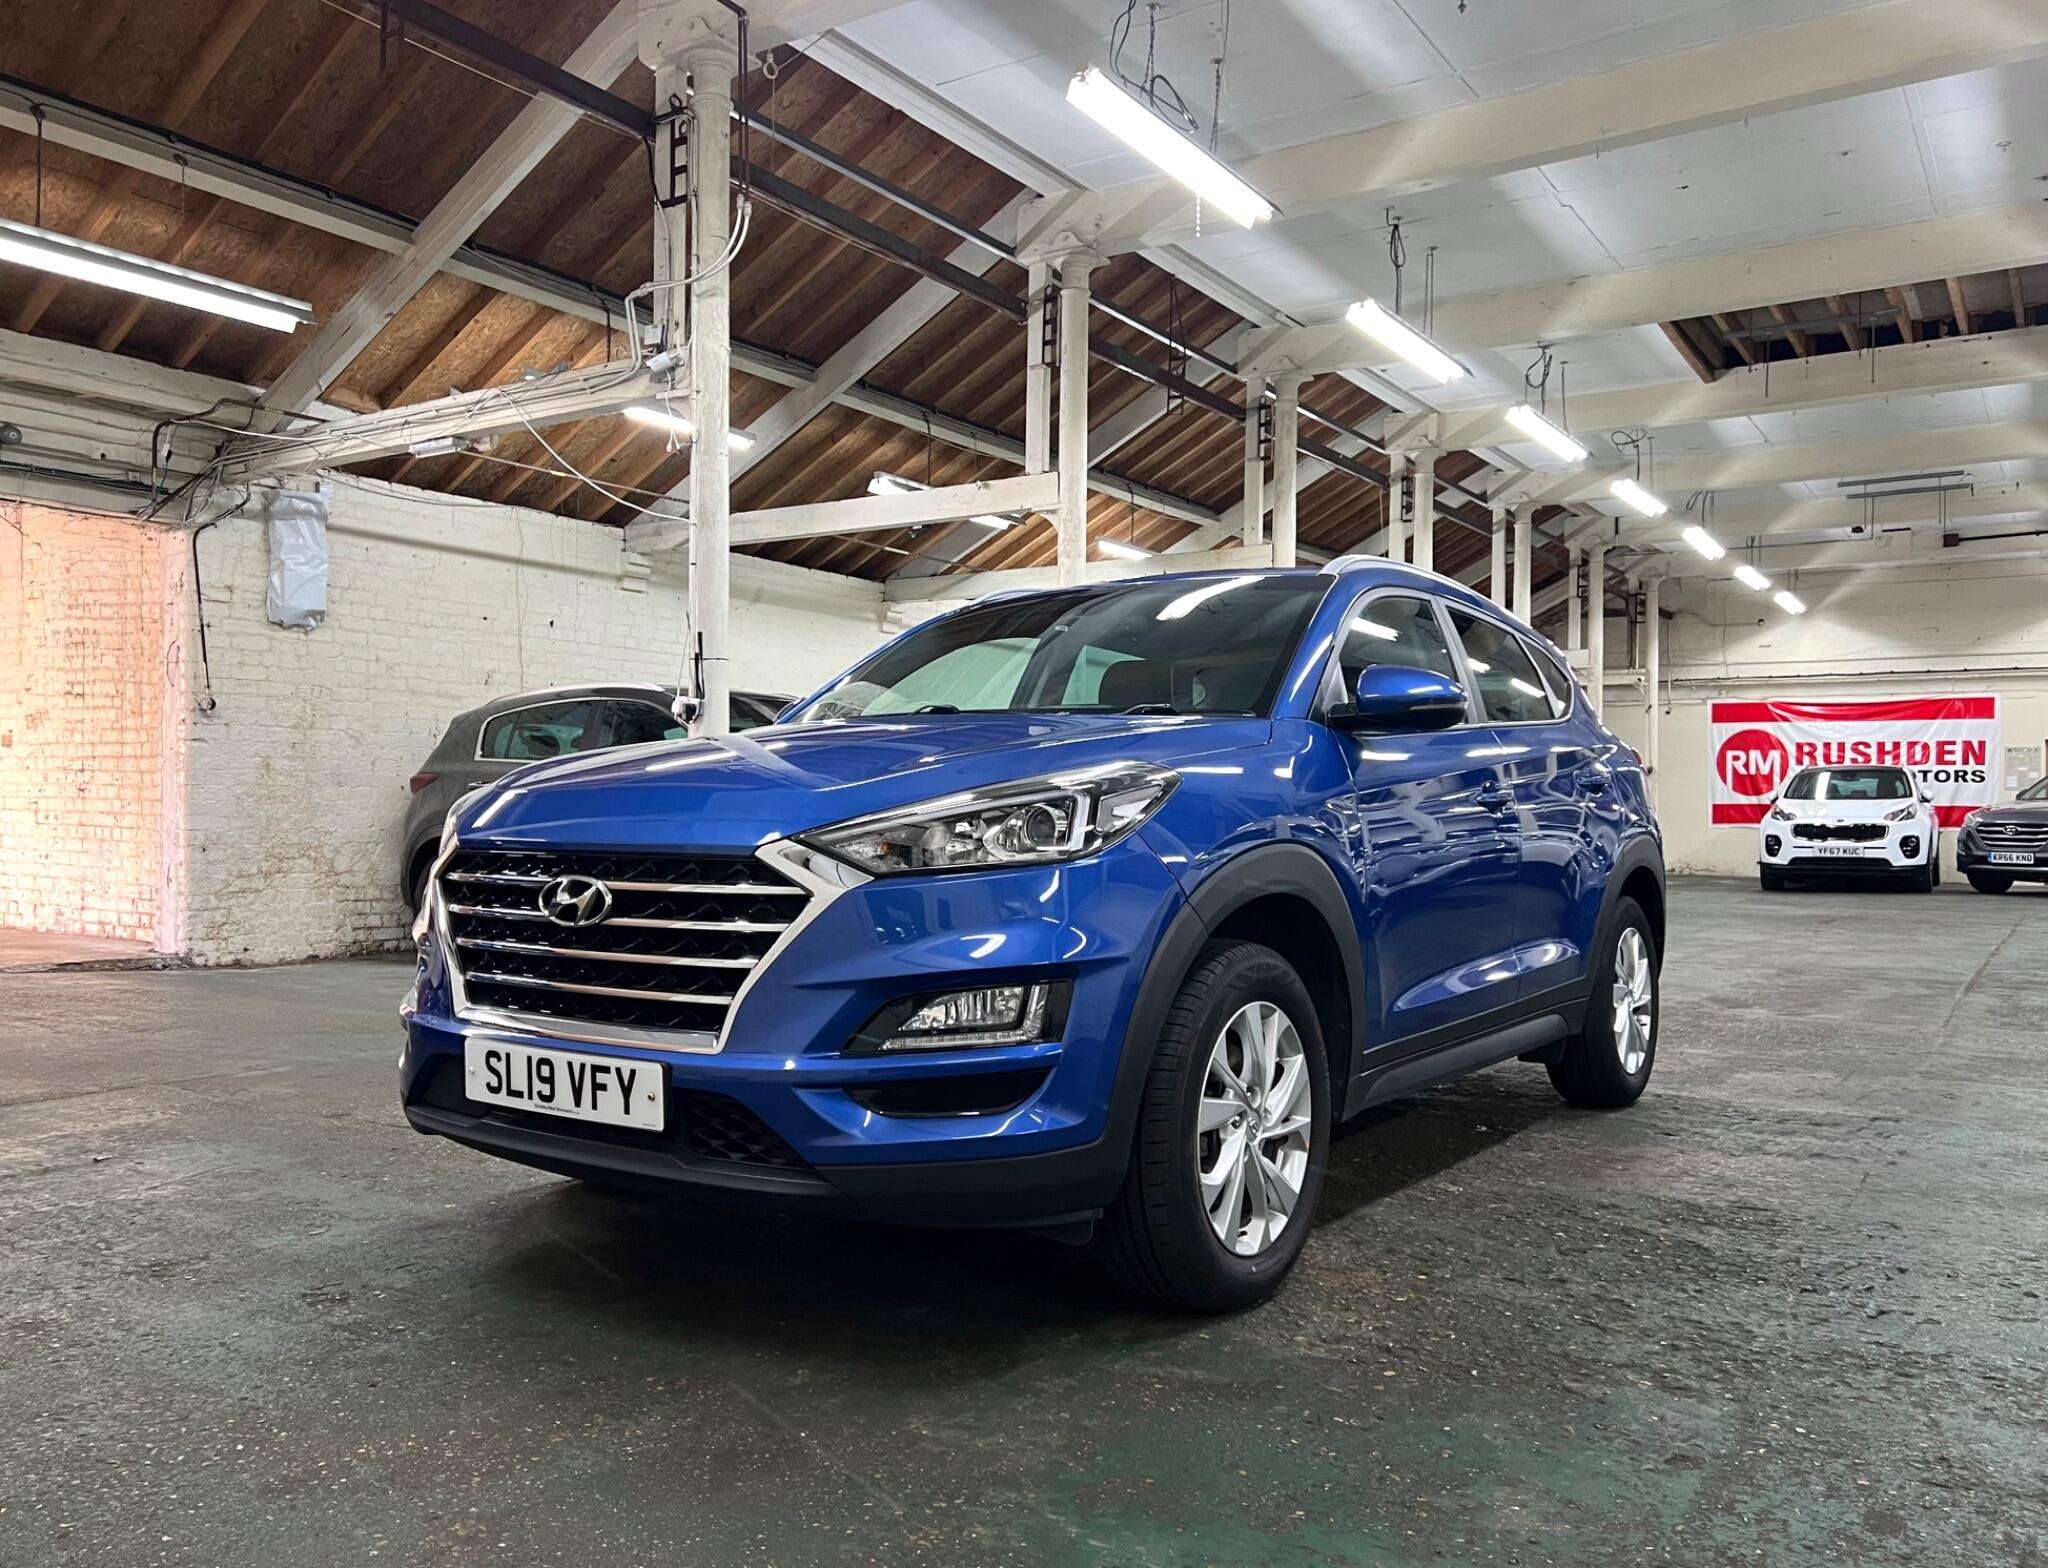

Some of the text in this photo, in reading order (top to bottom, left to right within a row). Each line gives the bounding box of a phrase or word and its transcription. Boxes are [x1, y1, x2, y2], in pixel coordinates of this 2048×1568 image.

[1795, 740, 1987, 766] RUSHDEN
[1726, 750, 1781, 790] RM
[1911, 769, 1987, 784] TORS
[1818, 847, 1860, 856] YF67 KUC
[485, 1049, 637, 1116] SL19 VFY
